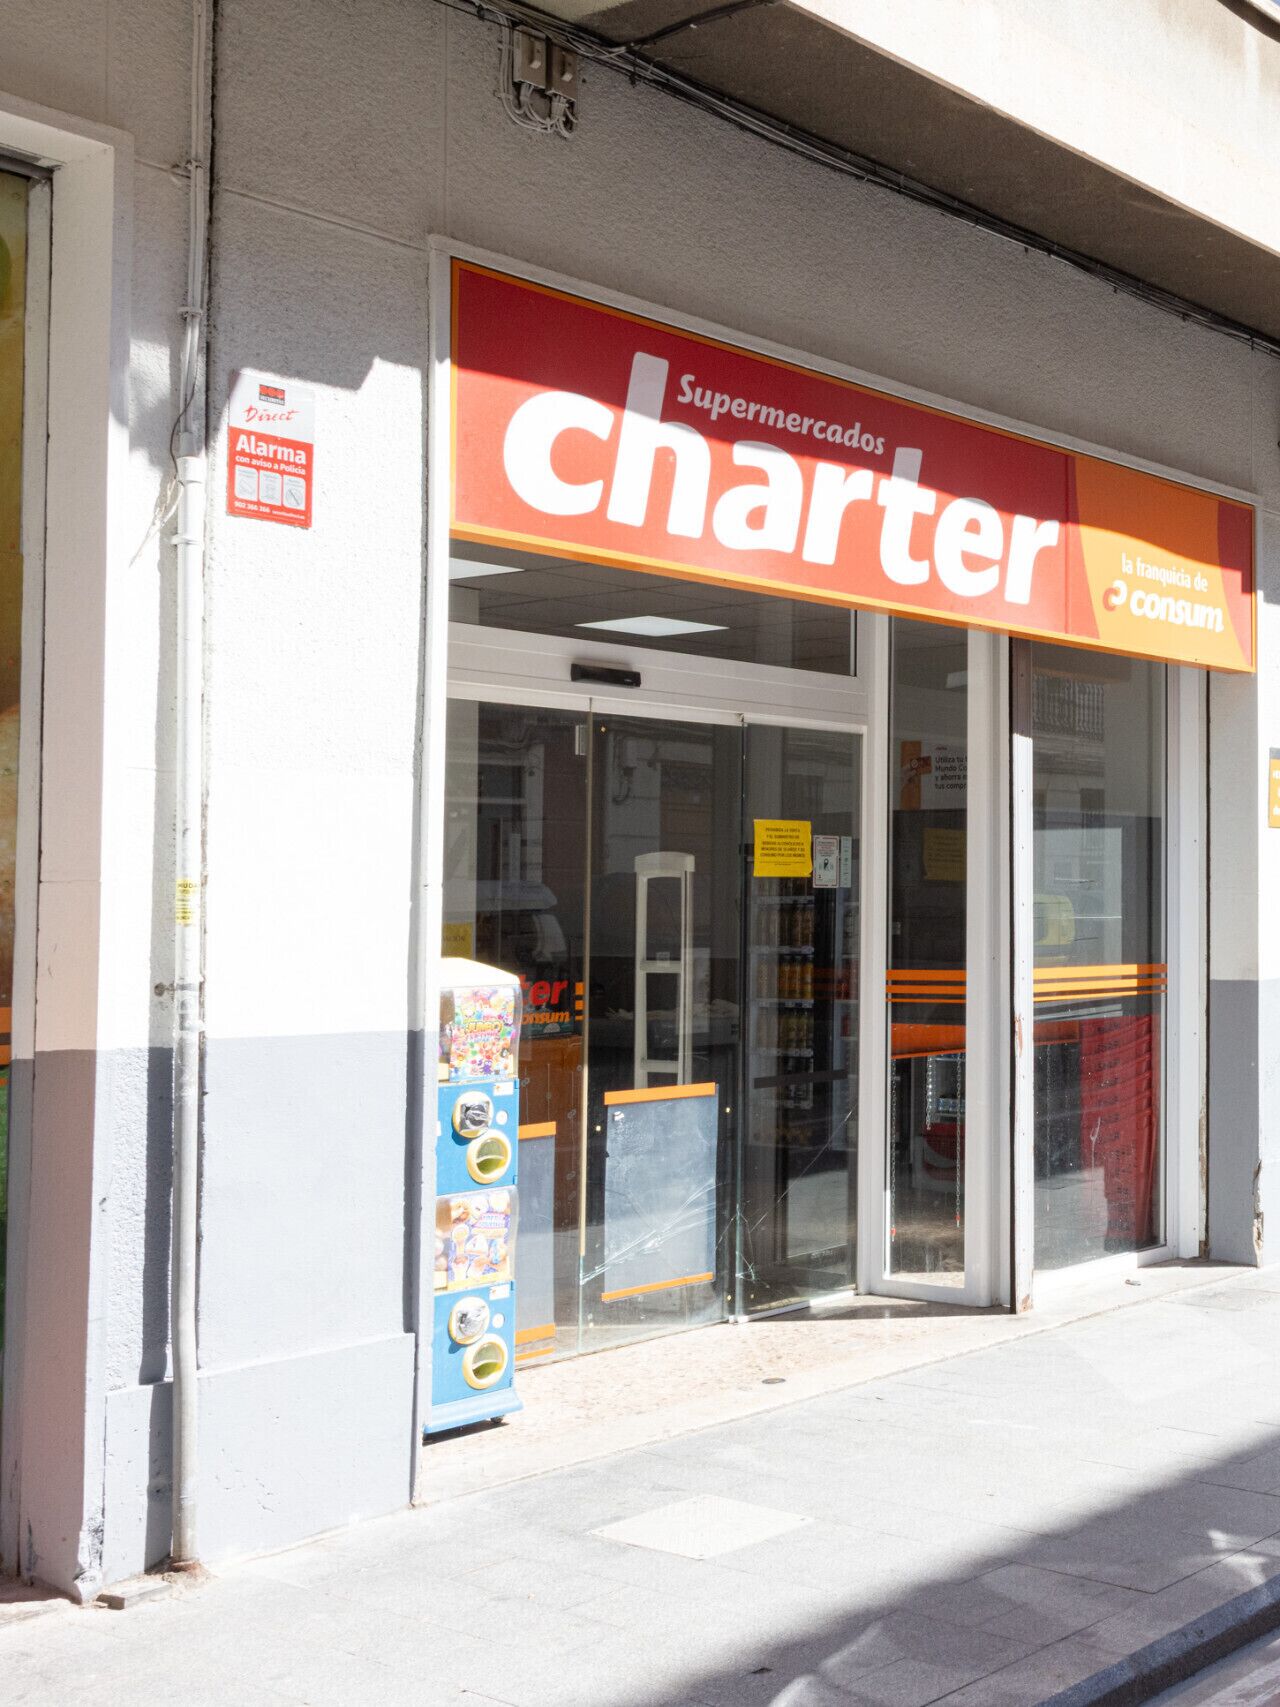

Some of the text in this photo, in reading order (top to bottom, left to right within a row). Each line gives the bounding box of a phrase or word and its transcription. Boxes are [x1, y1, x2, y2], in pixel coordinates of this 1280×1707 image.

[242, 404, 302, 423] Direct
[677, 373, 887, 456] Supermercados
[235, 434, 307, 465] Alarma
[235, 455, 250, 464] con
[251, 458, 273, 469] aviso
[273, 463, 280, 471] a
[502, 350, 1060, 605] charter
[1121, 551, 1209, 593] la franquicia de
[1129, 588, 1225, 633] consum
[946, 783, 967, 792] compr
